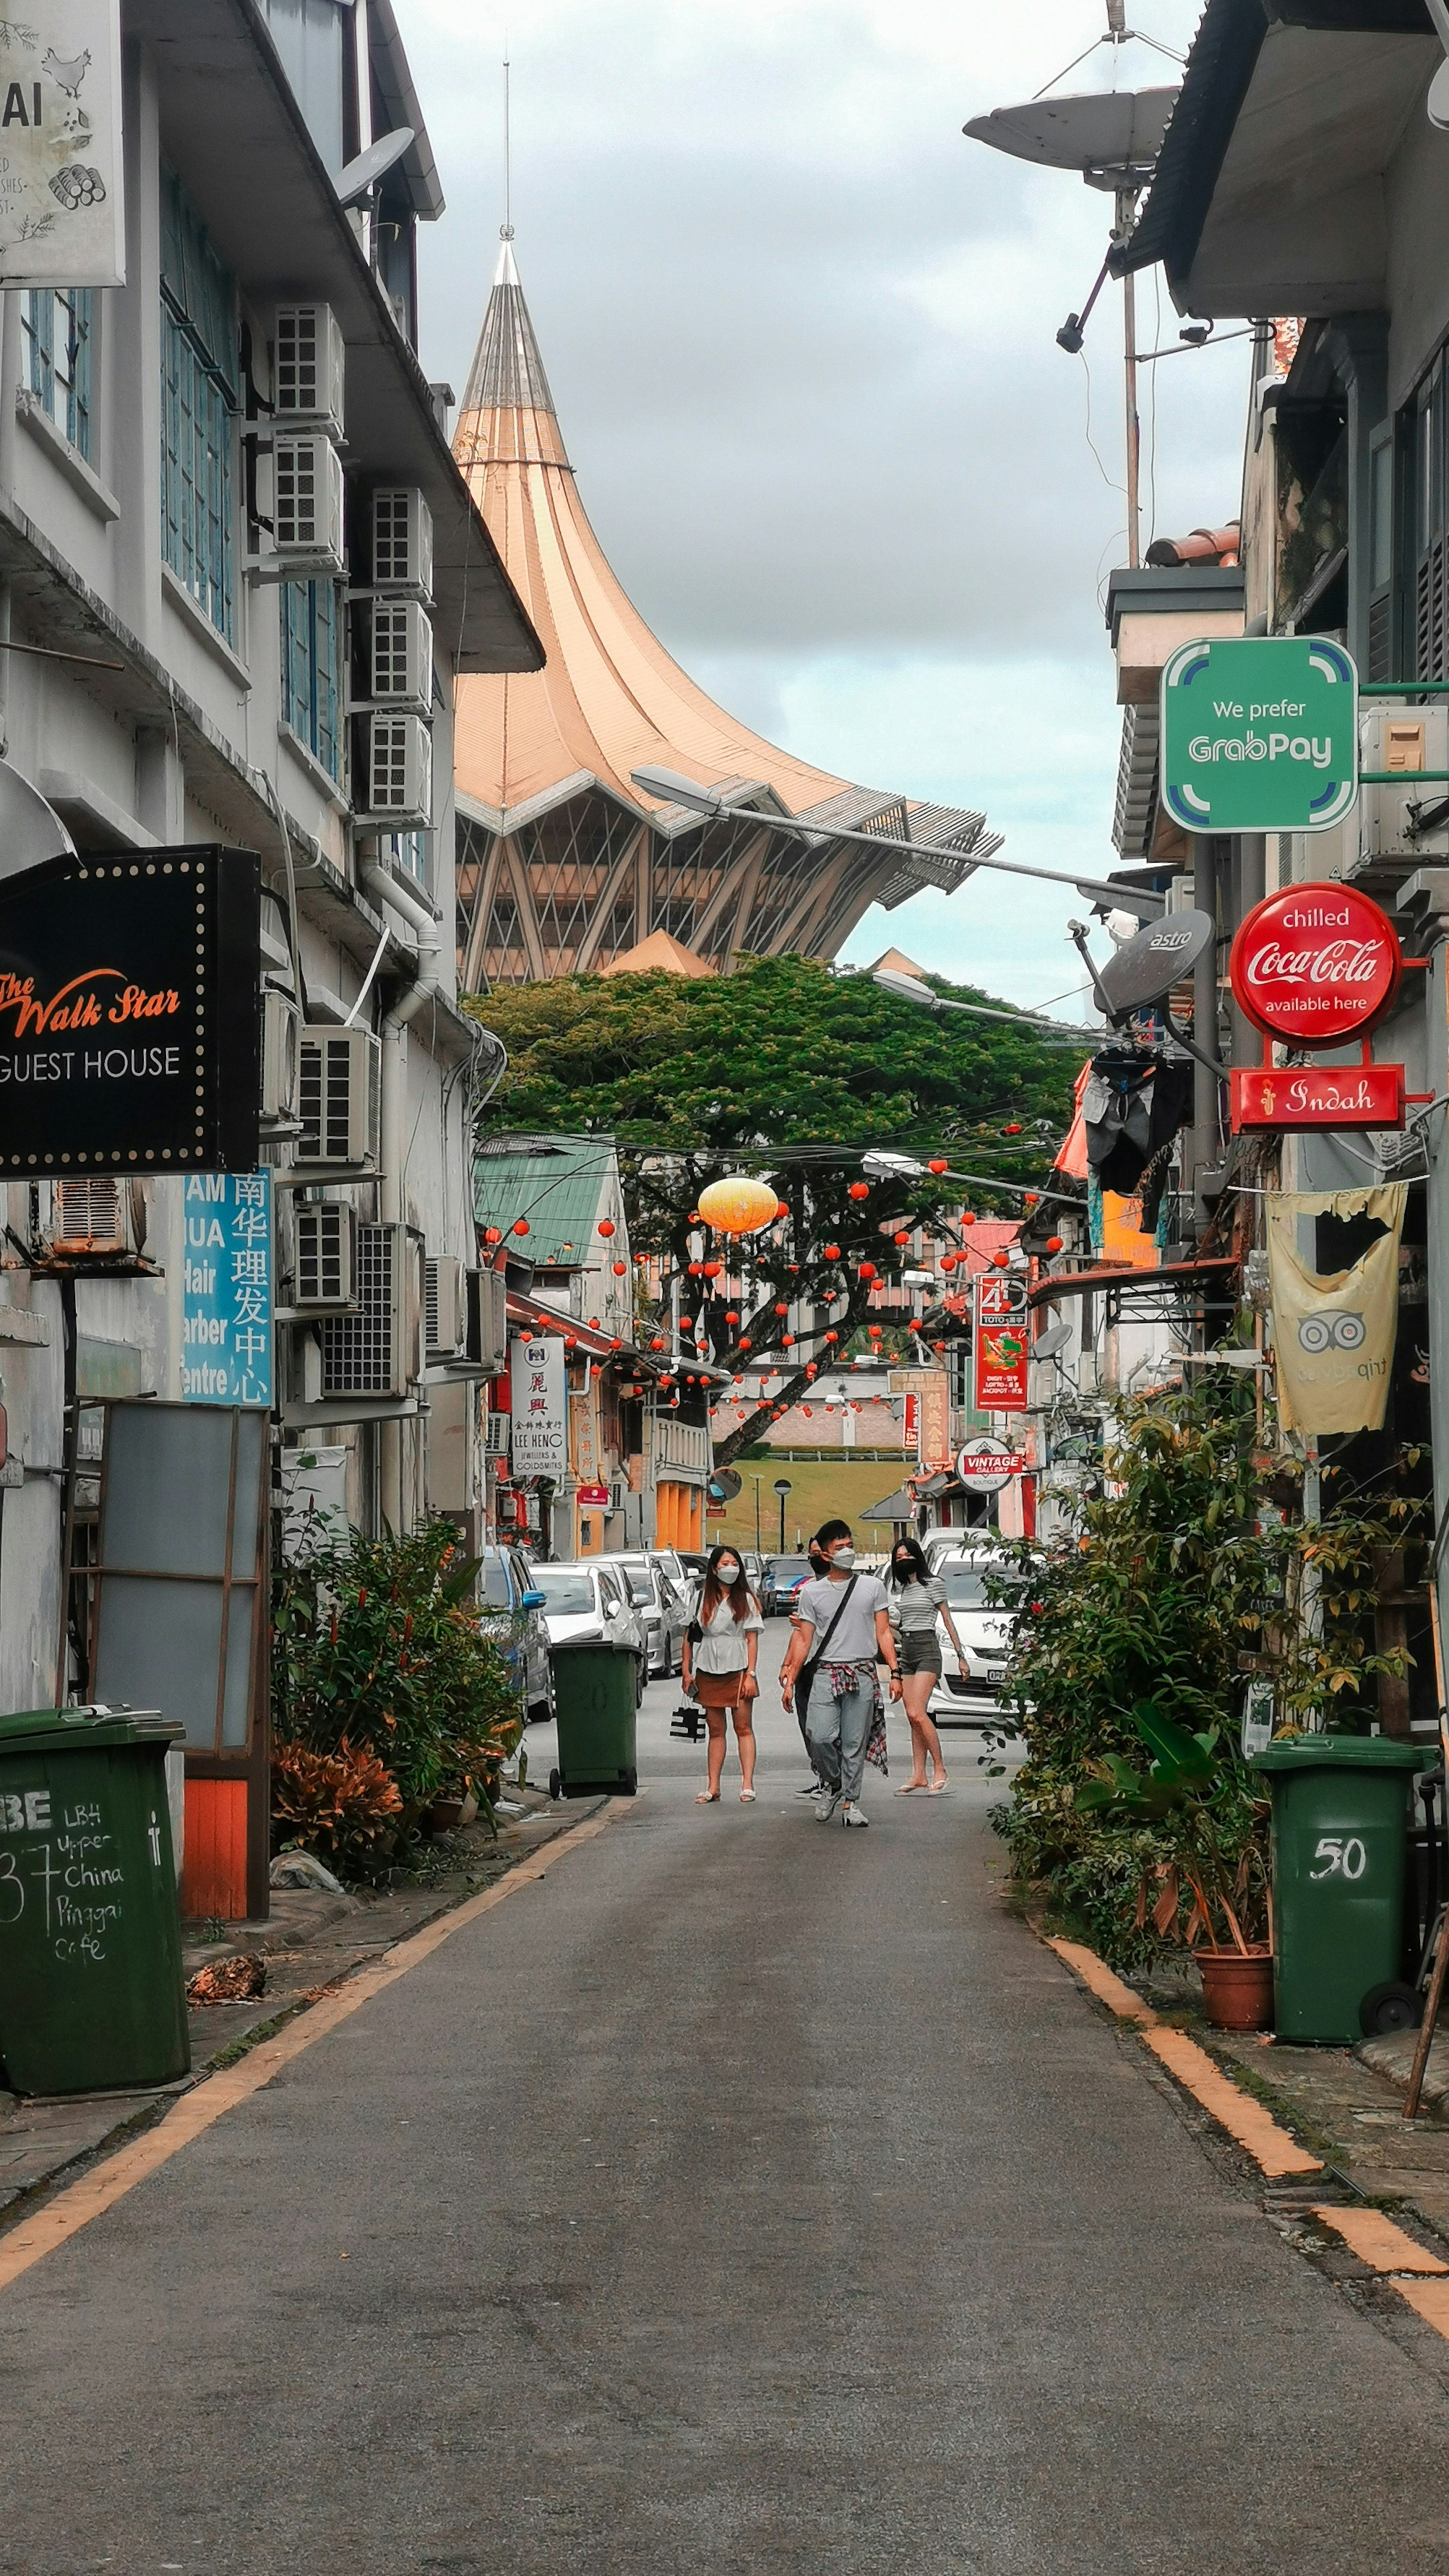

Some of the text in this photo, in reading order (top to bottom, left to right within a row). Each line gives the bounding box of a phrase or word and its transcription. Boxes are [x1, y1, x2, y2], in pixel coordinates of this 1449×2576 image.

[0, 157, 9, 173] D
[1213, 699, 1307, 721] We prefer
[1187, 729, 1333, 769] GrabPay
[1282, 907, 1350, 929] chilled
[1150, 930, 1192, 949] astro
[0, 972, 35, 1004] The
[0, 972, 181, 1038] Walk Star
[1265, 996, 1367, 1013] available here
[0, 1046, 181, 1083] GUEST HOUSE
[1285, 1079, 1375, 1113] Indah
[231, 1173, 268, 1404] 南华理发中心
[981, 1278, 1028, 1312] 4D
[515, 1434, 528, 1448] LEE
[968, 1456, 1020, 1468] VINTAGE
[1310, 1838, 1367, 1880] 50
[64, 1863, 124, 1887] China
